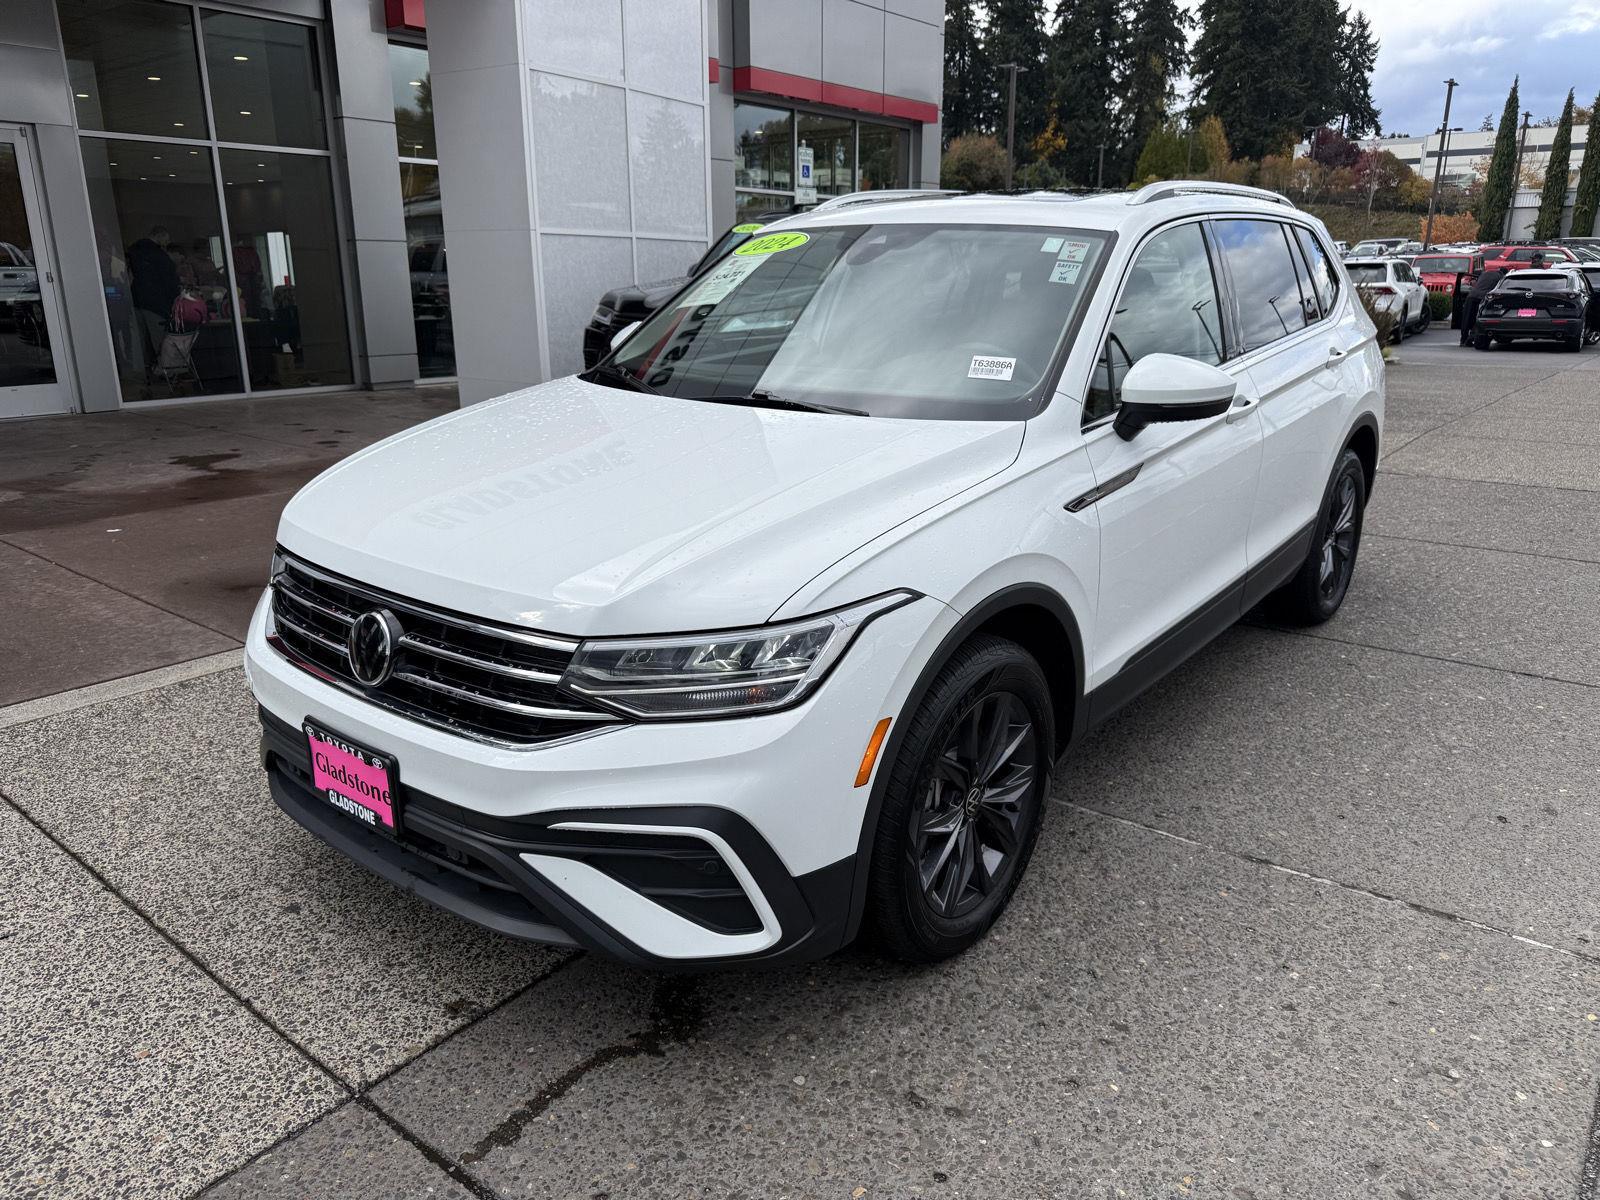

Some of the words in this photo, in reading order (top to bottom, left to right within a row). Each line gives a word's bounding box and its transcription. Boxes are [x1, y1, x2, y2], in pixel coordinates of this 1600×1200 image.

[740, 235, 803, 254] 2024
[1057, 262, 1080, 270] SAFETY
[319, 732, 365, 761] TOYOTA
[315, 752, 393, 806] Gladstone
[328, 789, 376, 826] GLADSTONE
